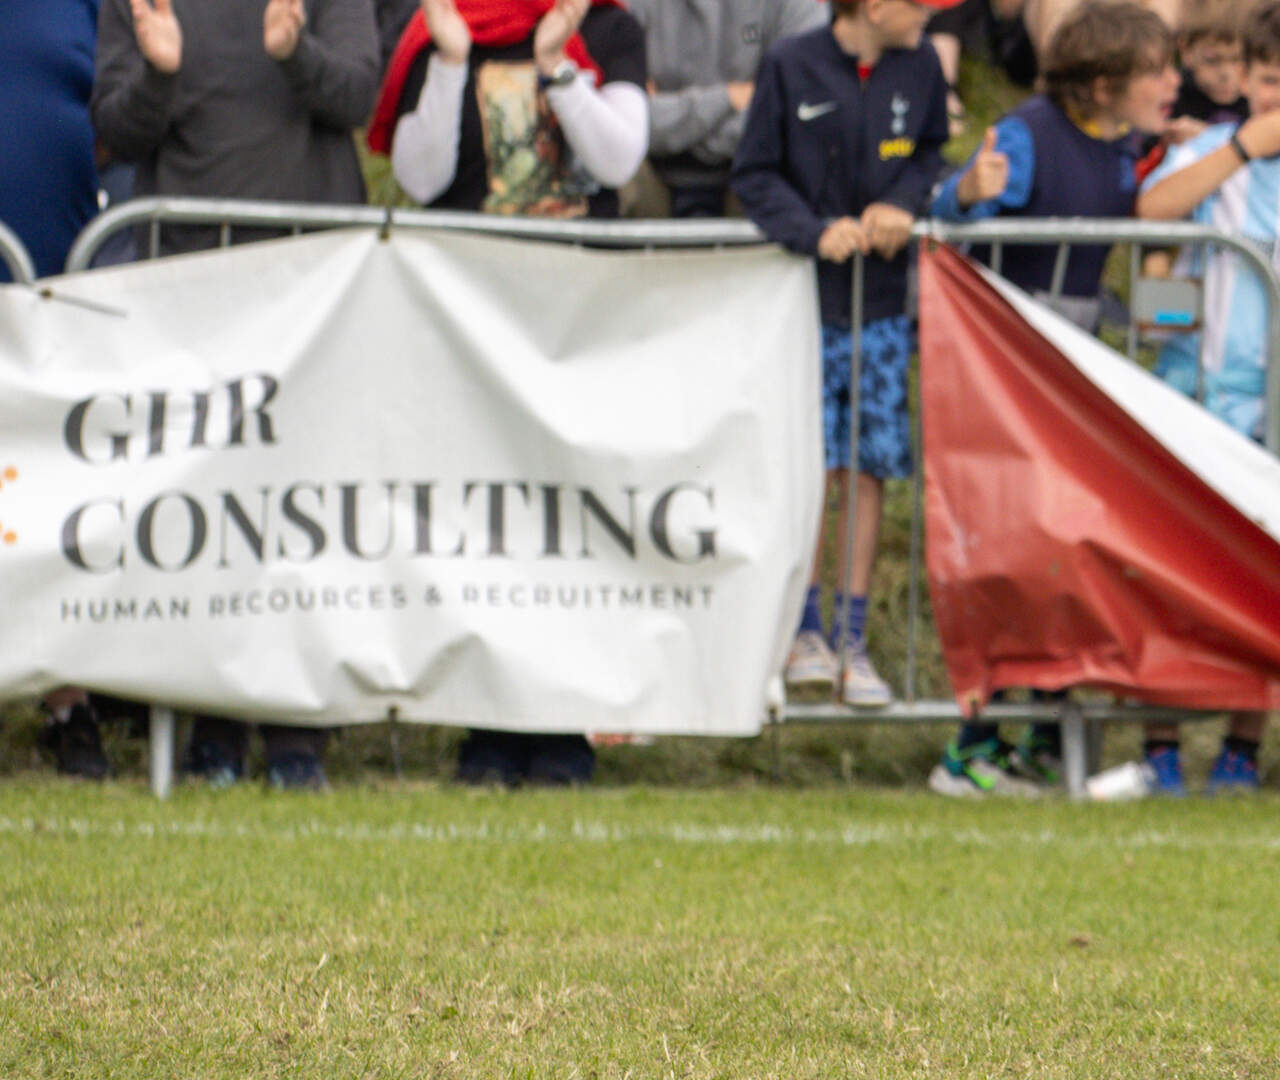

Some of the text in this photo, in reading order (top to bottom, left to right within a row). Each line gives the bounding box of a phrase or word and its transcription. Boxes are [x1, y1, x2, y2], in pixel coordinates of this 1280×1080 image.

[61, 372, 281, 465] GHR
[60, 479, 719, 575] CONSULTING
[60, 595, 191, 624] HUMAN
[423, 583, 443, 609] &
[460, 583, 716, 610] RECRUITMENT
